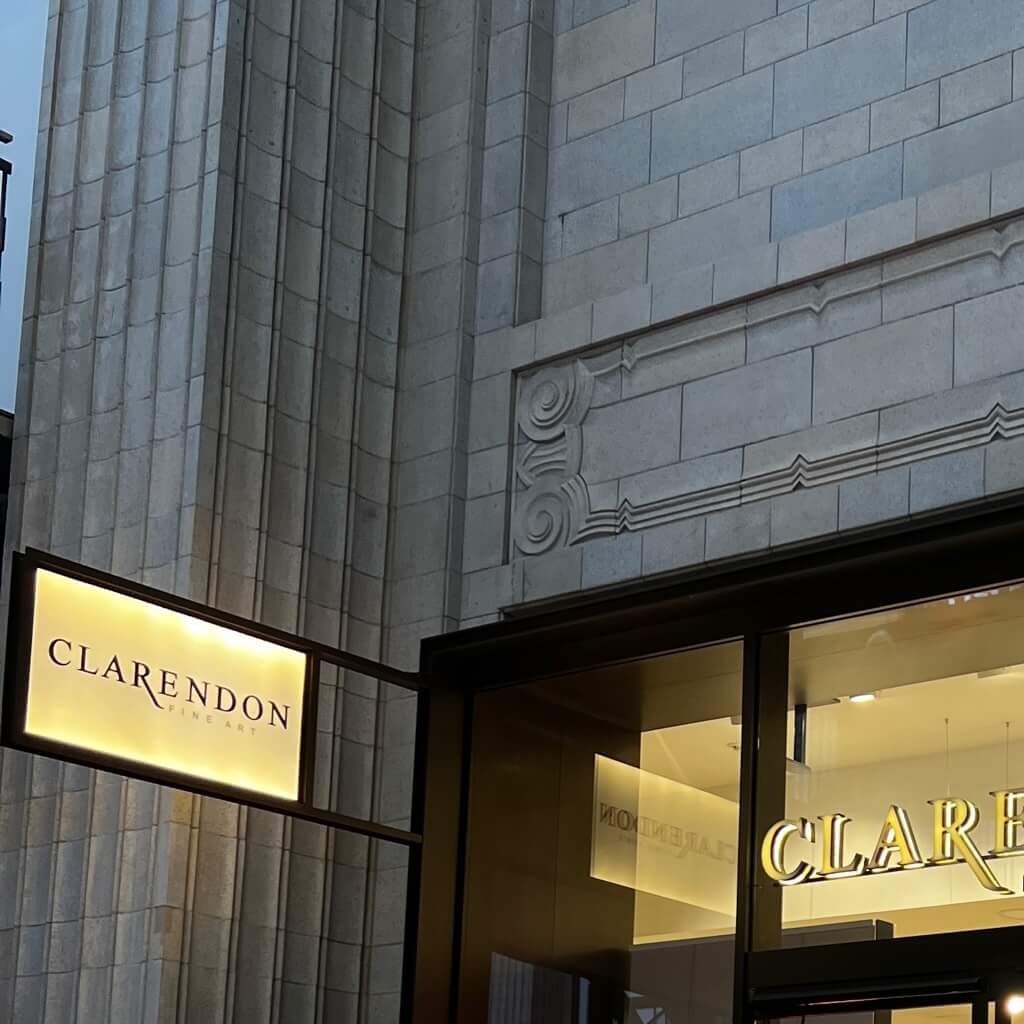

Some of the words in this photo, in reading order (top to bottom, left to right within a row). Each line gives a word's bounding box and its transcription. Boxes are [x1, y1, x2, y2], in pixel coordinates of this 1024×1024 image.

[48, 638, 291, 730] CLARENDON
[168, 704, 214, 724] FINE
[225, 721, 257, 736] ART
